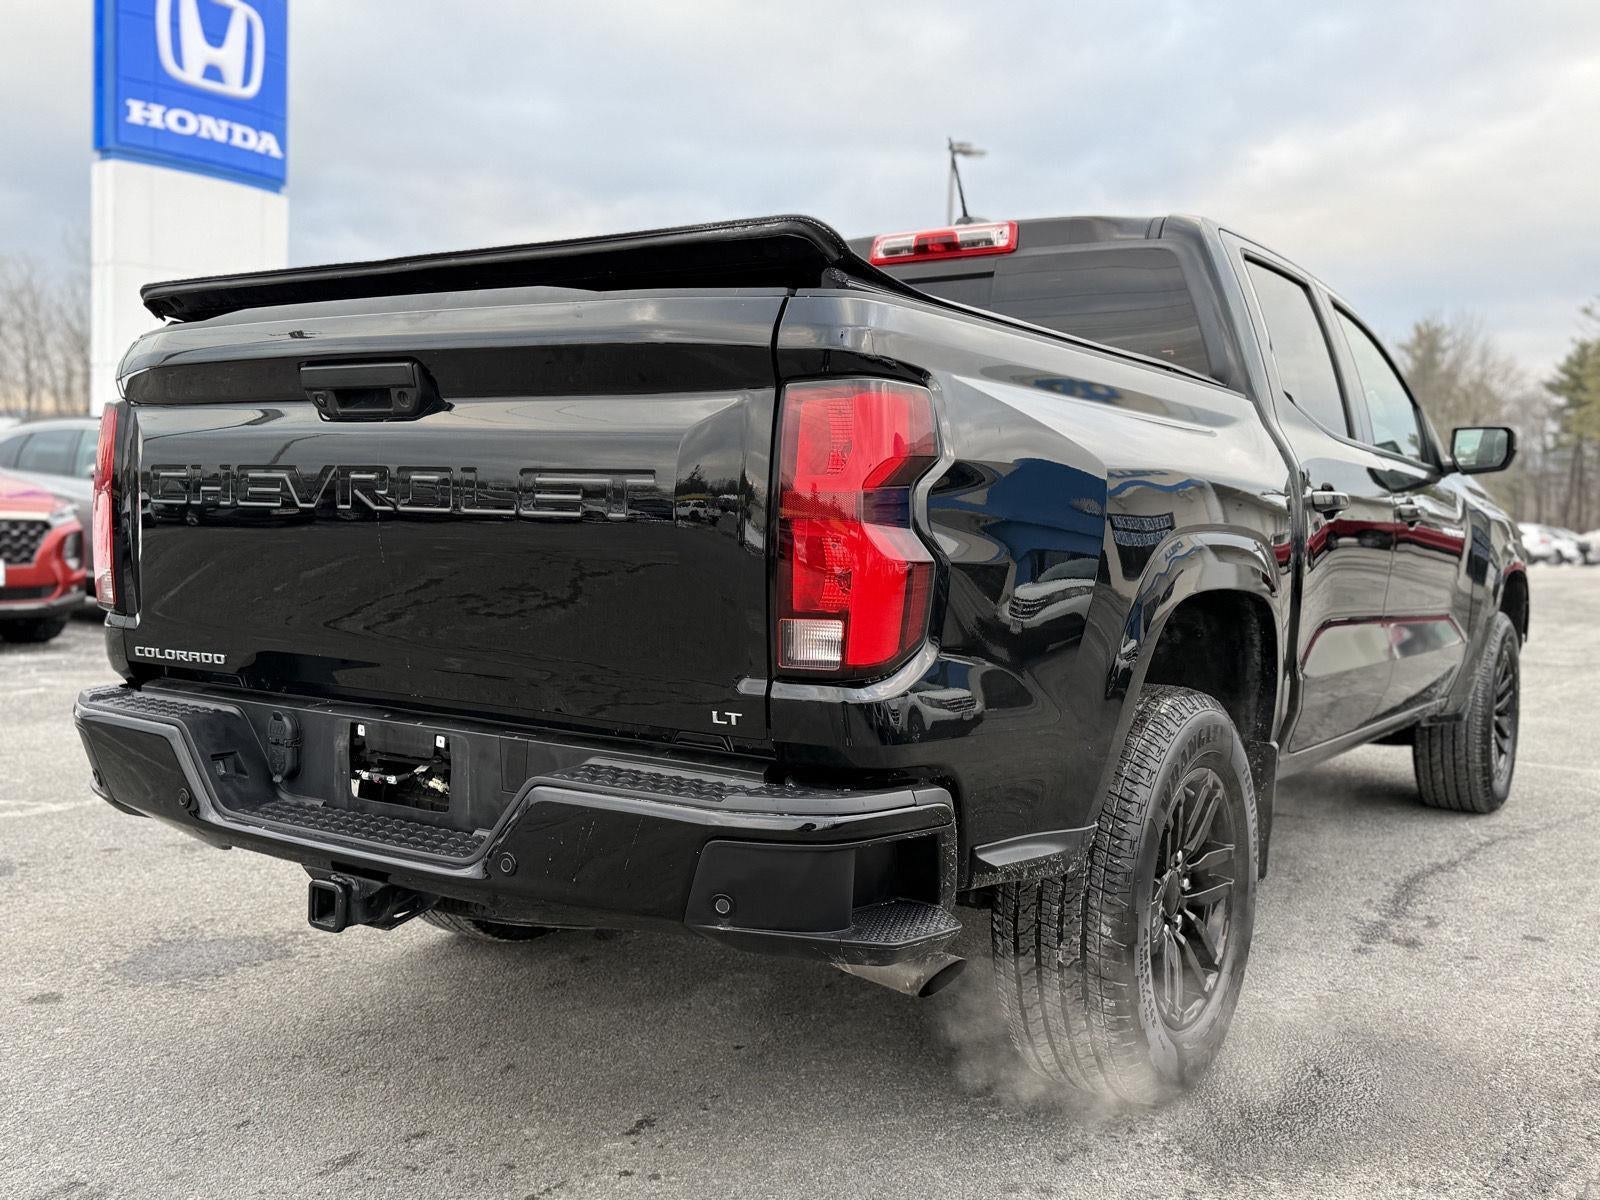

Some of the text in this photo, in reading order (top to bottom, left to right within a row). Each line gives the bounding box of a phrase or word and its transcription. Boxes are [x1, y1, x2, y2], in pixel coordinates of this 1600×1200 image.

[125, 98, 284, 160] HONDA
[150, 464, 656, 518] CHEVROLET
[134, 646, 226, 665] COLORADO
[711, 710, 743, 726] LT
